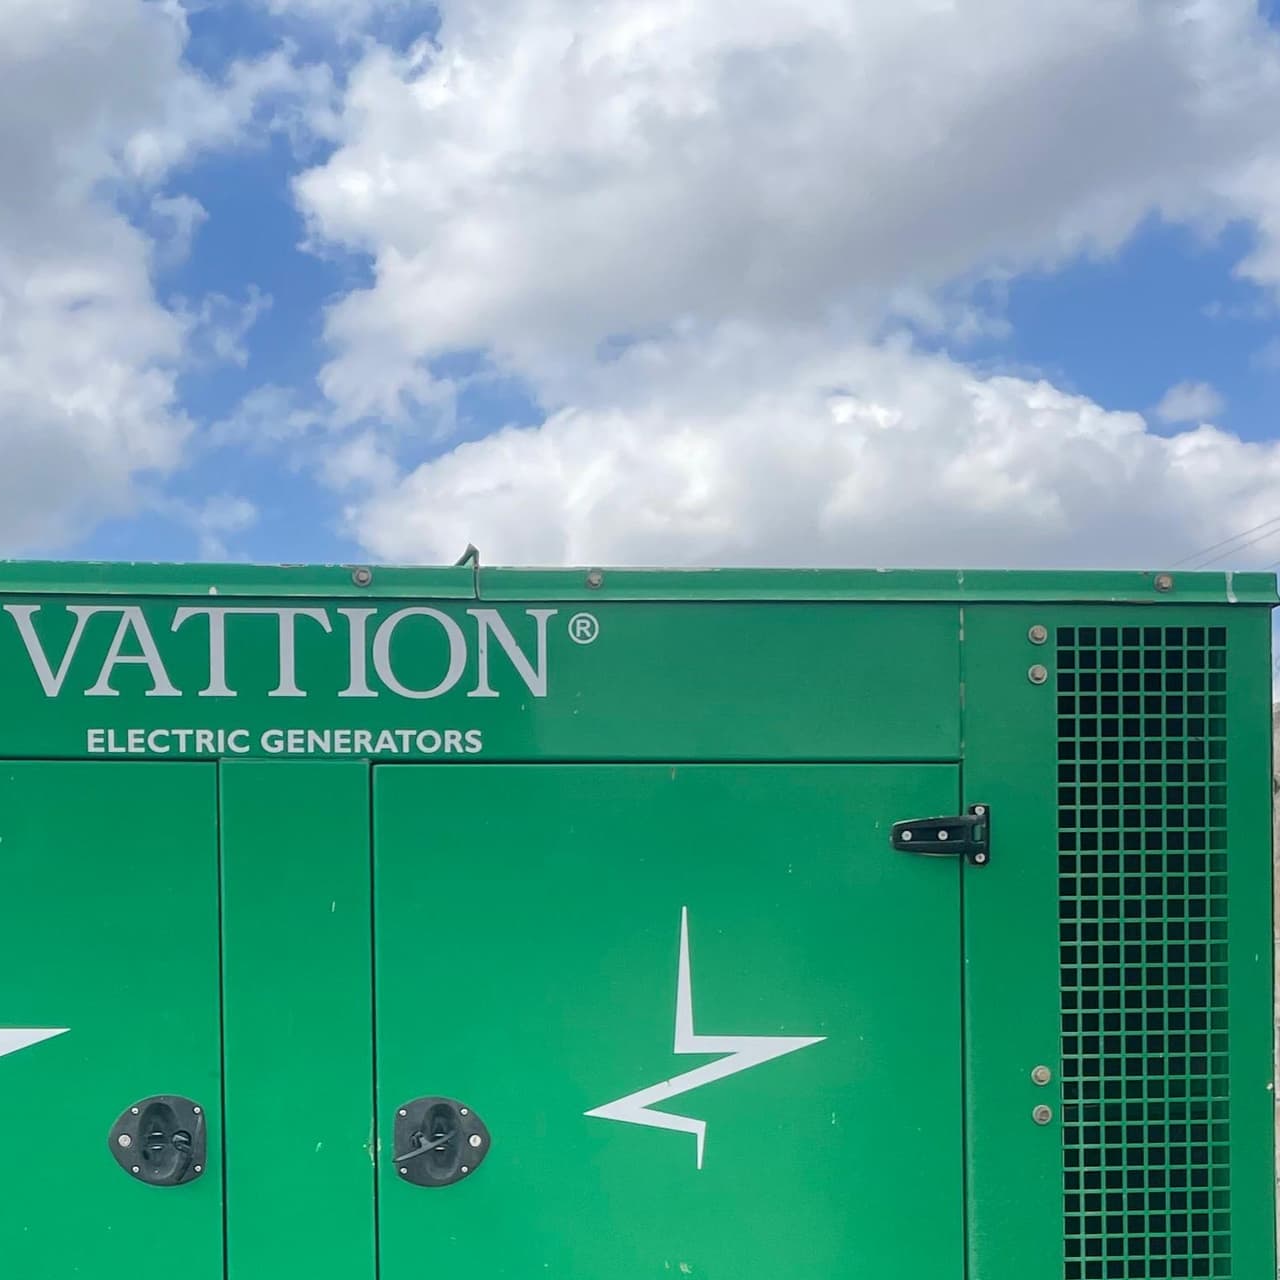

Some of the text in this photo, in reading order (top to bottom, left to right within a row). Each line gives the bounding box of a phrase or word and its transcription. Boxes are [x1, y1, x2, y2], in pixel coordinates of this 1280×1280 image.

[3, 603, 559, 700] VATTION
[86, 728, 483, 754] ELECTRIC GENERATORS
